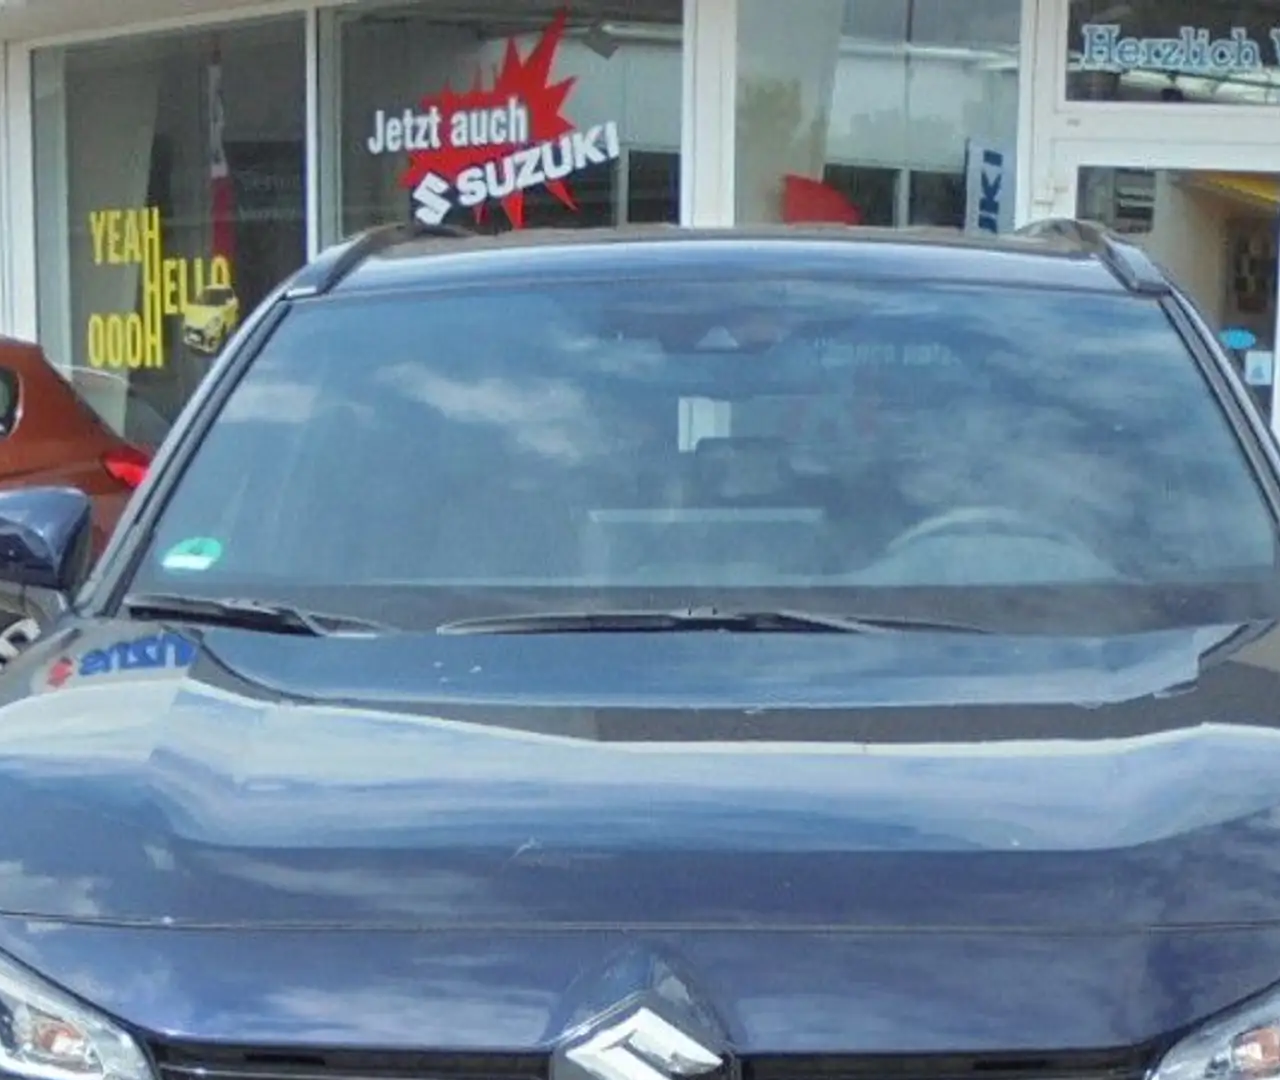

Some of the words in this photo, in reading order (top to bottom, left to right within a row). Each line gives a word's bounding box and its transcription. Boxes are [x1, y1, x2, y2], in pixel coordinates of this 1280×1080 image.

[1081, 24, 1263, 70] Herzlich
[368, 106, 441, 154] Jetzt
[450, 96, 529, 147] auch
[456, 121, 620, 207] SUZUKI
[90, 207, 160, 266] YEAH
[89, 312, 163, 369] OOOH
